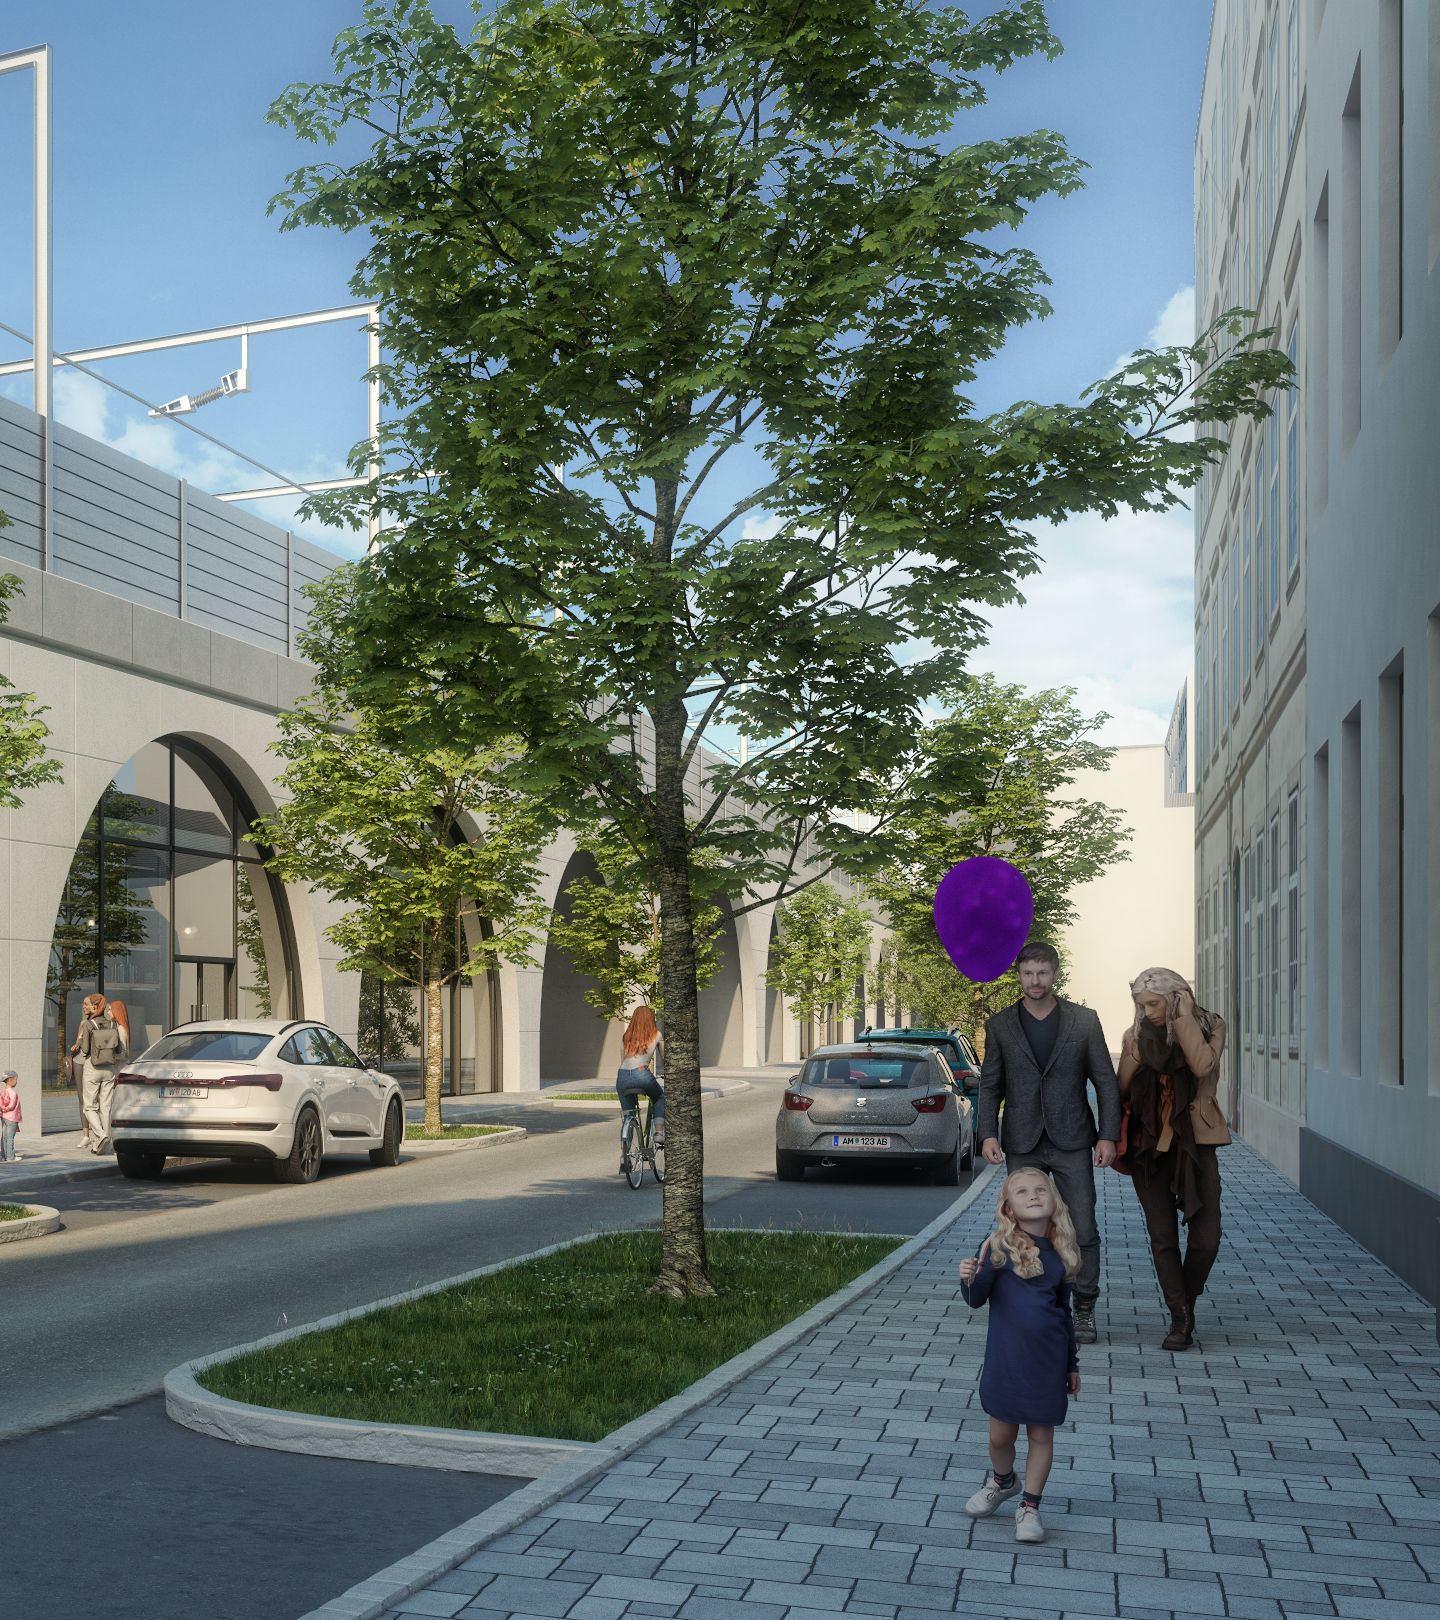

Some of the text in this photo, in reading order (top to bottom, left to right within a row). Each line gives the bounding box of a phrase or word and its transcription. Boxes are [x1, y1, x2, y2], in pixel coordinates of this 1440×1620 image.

[842, 1137, 888, 1146] AM 123 AB
